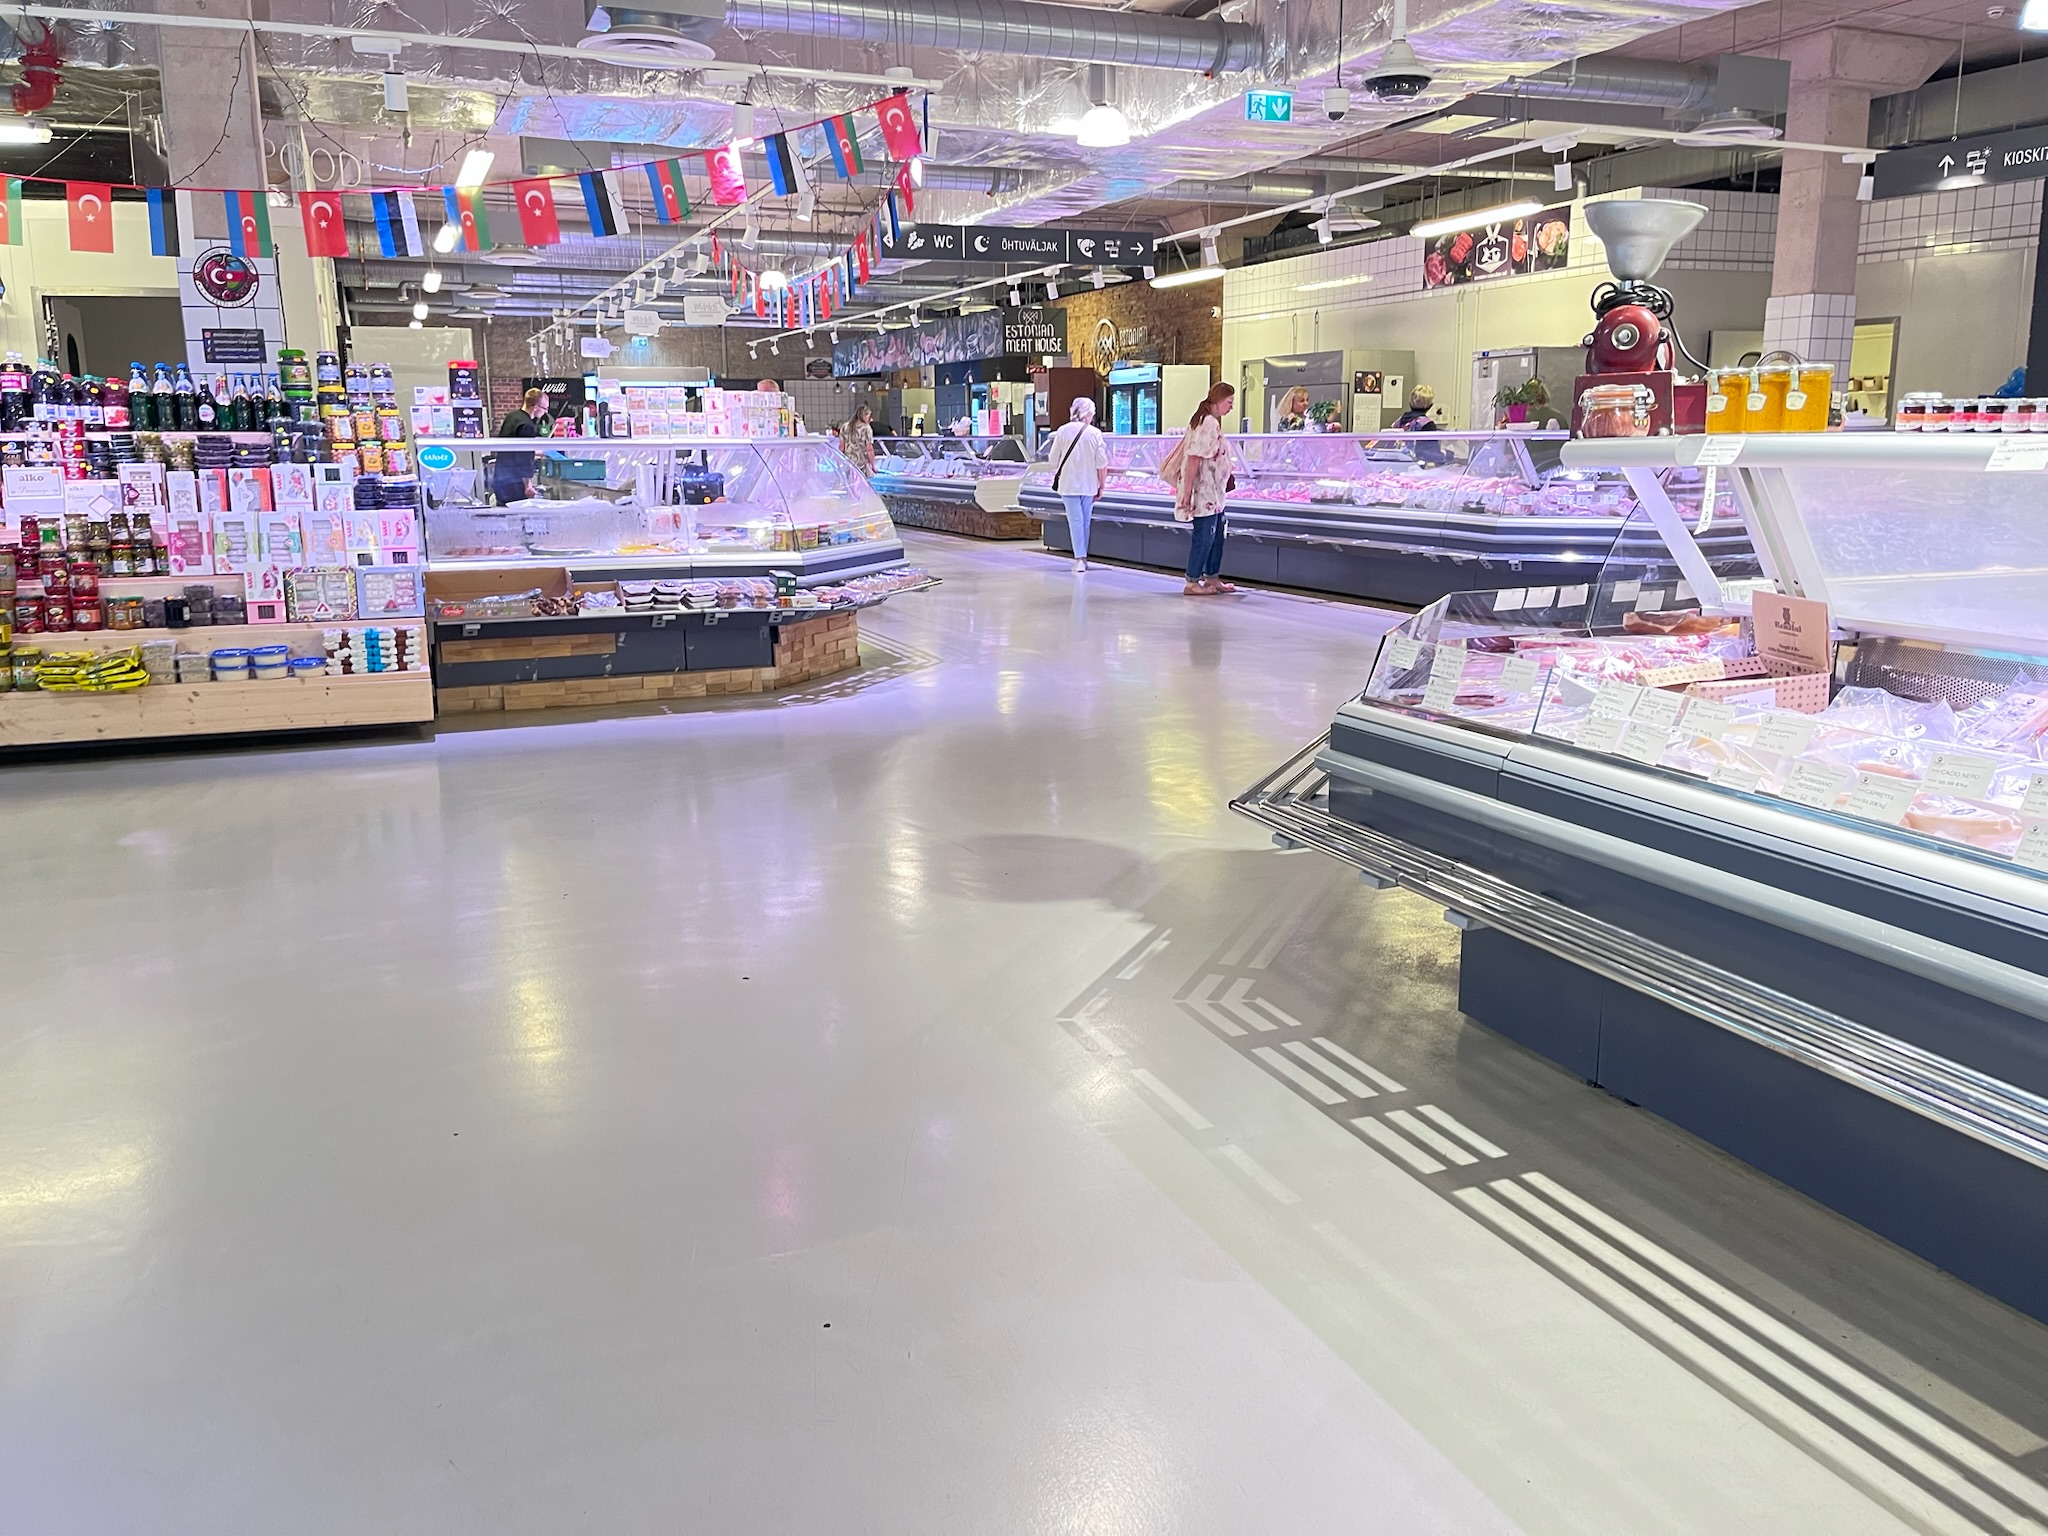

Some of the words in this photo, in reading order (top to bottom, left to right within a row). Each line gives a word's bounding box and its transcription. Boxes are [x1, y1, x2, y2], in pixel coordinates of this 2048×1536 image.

[933, 234, 954, 249] WC
[1001, 237, 1058, 252] ÕHTUVÄLJAK
[1005, 323, 1055, 338] ESTONIAN
[1005, 338, 1033, 353] MEAT
[1035, 337, 1062, 353] HOUSE
[19, 473, 44, 482] alko
